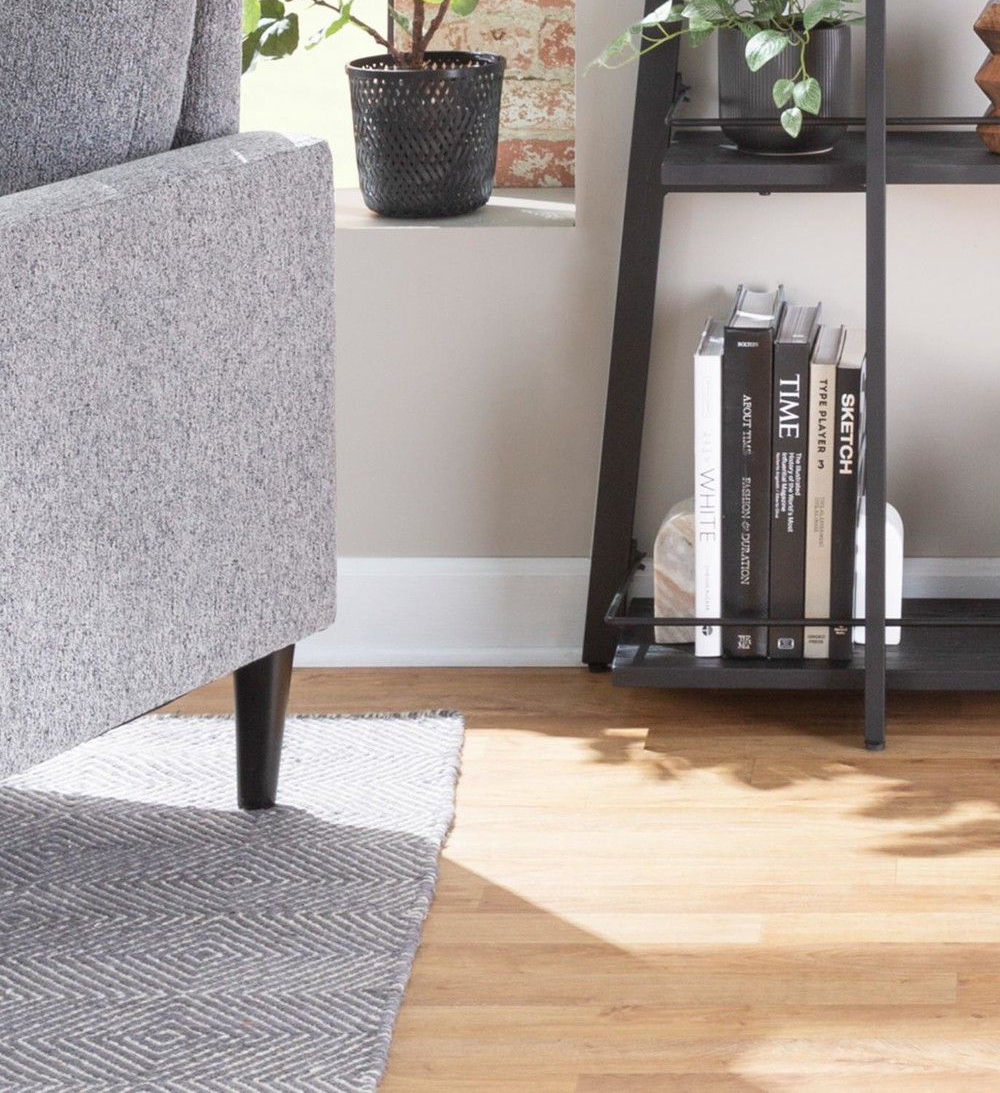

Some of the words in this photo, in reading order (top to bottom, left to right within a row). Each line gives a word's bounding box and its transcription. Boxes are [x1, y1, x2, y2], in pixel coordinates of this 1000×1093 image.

[742, 394, 752, 428] ABOUT
[779, 373, 801, 439] TIME
[818, 379, 828, 406] TYPE
[742, 430, 752, 456] TIME
[817, 410, 828, 454] PLAYER
[839, 393, 856, 475] SKETCH
[787, 452, 795, 474] History
[795, 452, 803, 464] The
[741, 477, 751, 519] FASHION
[794, 465, 802, 496] Illustrated
[699, 468, 716, 542] WHITE
[740, 533, 751, 585] DURATION
